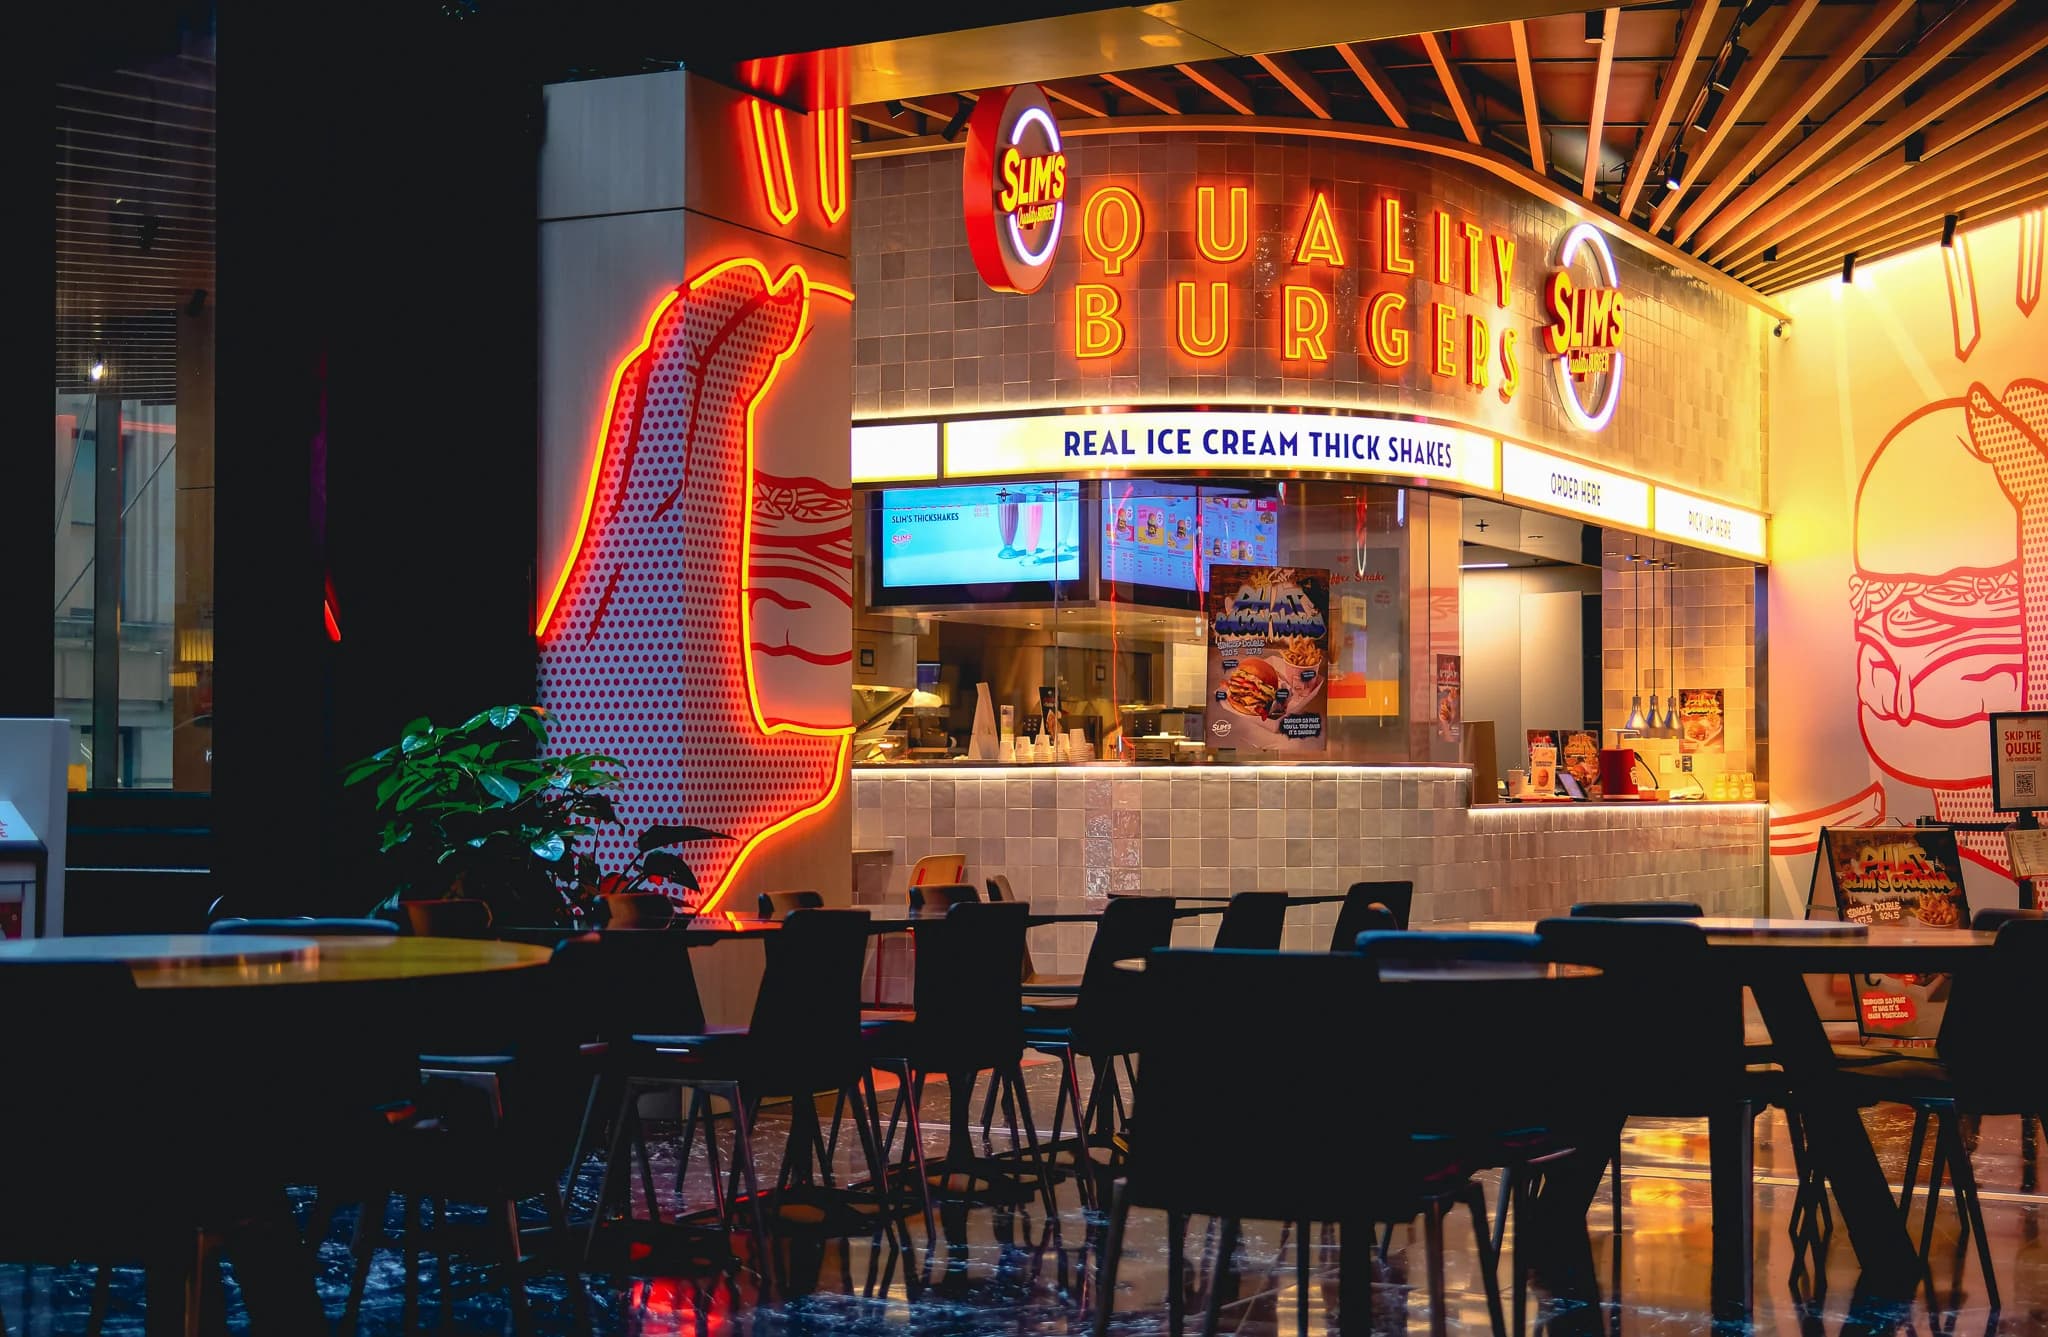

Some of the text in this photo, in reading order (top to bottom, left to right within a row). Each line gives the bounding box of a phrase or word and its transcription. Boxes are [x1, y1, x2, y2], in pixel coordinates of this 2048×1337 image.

[1001, 148, 1066, 212] SLIM'S
[1082, 186, 1516, 307] QUALITY
[1548, 270, 1625, 354] SLIM'S
[1074, 281, 1519, 398] BURGERS
[1064, 428, 1452, 468] REAL ICE CREAM THICK SHAKES
[1550, 471, 1601, 507] ORDER HERE
[891, 512, 960, 524] SLIM'S THICKSHAKES
[1688, 509, 1704, 533] PICK
[1715, 518, 1732, 540] HERE
[2004, 730, 2041, 741] SKIP THE
[2005, 741, 2042, 757] QUEUE
